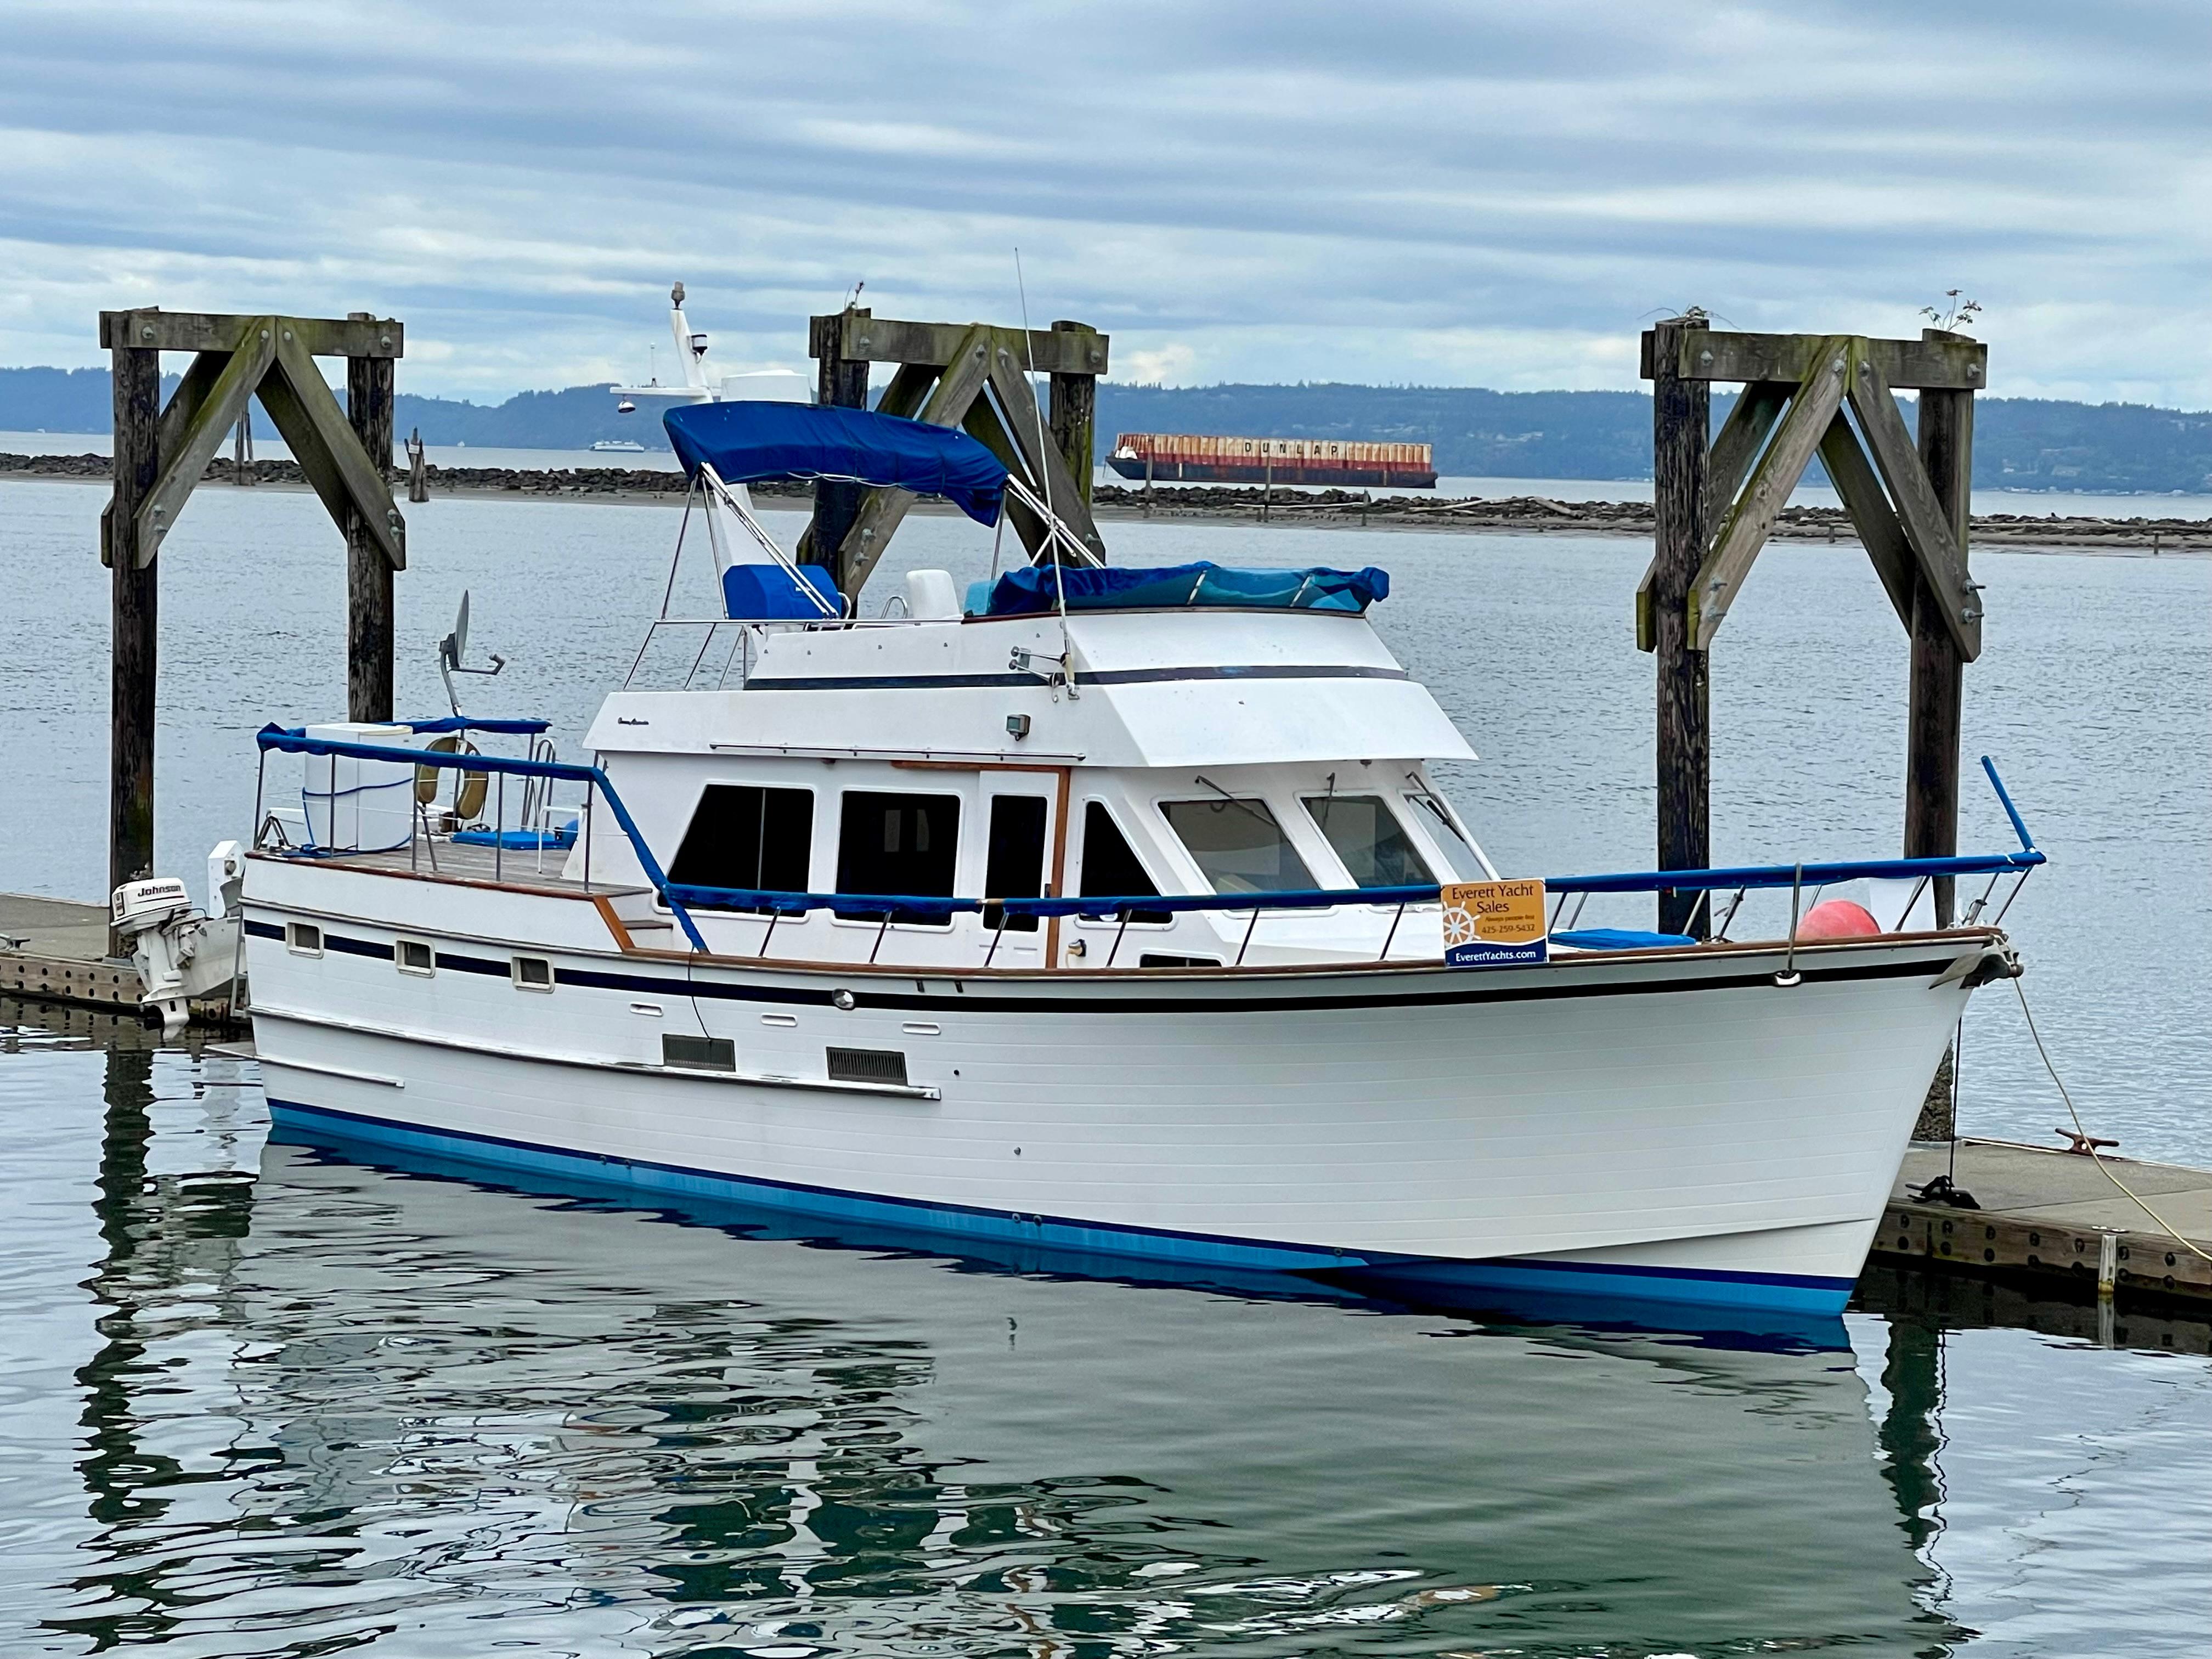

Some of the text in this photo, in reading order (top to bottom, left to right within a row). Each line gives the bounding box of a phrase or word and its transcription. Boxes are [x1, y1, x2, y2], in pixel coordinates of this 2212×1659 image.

[1245, 442, 1338, 456] DUNLAP
[138, 885, 180, 896] Johnson
[1452, 883, 1534, 900] Everett Yacht
[1477, 900, 1510, 914] Sales
[1482, 924, 1535, 934] 425-259-5432
[1455, 951, 1536, 962] EverettYachts.com
